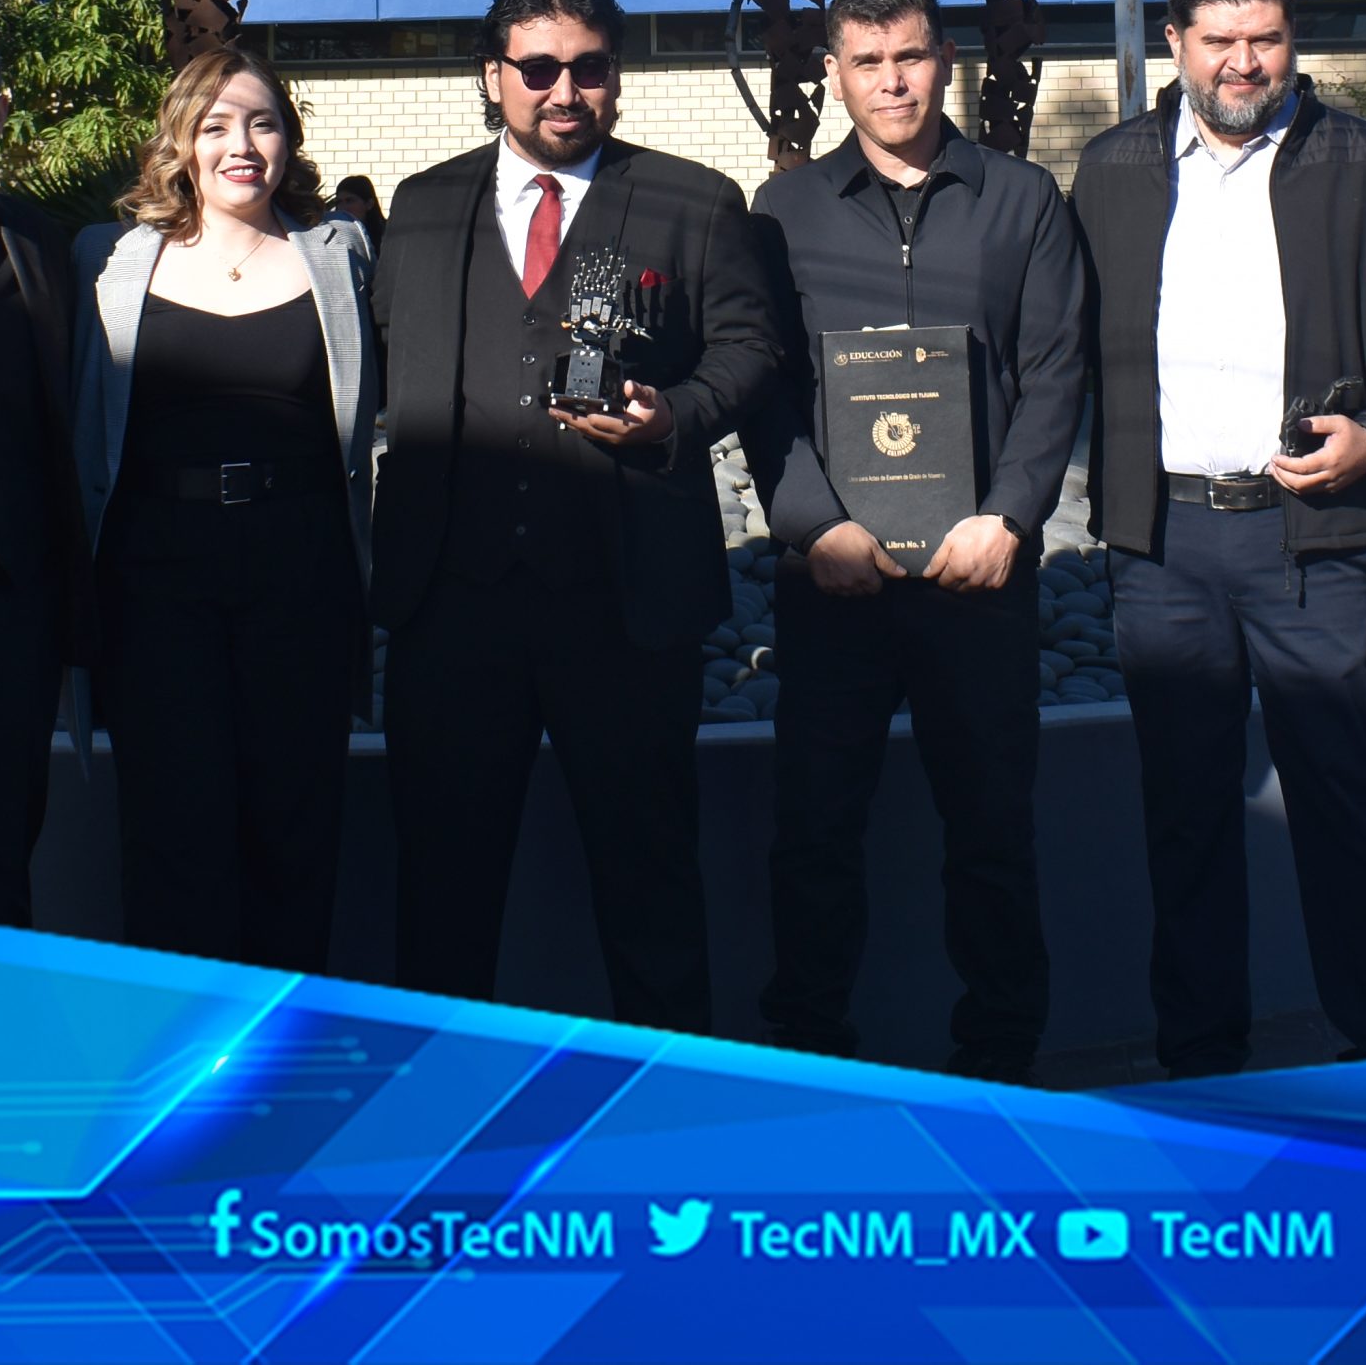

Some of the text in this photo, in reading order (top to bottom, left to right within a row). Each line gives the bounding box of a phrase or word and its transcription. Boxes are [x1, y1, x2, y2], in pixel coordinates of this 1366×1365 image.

[849, 349, 903, 361] EDUCACIÓN
[850, 394, 876, 402] INSTITUTO
[911, 392, 918, 400] DE
[886, 540, 926, 549] Libro No. 3
